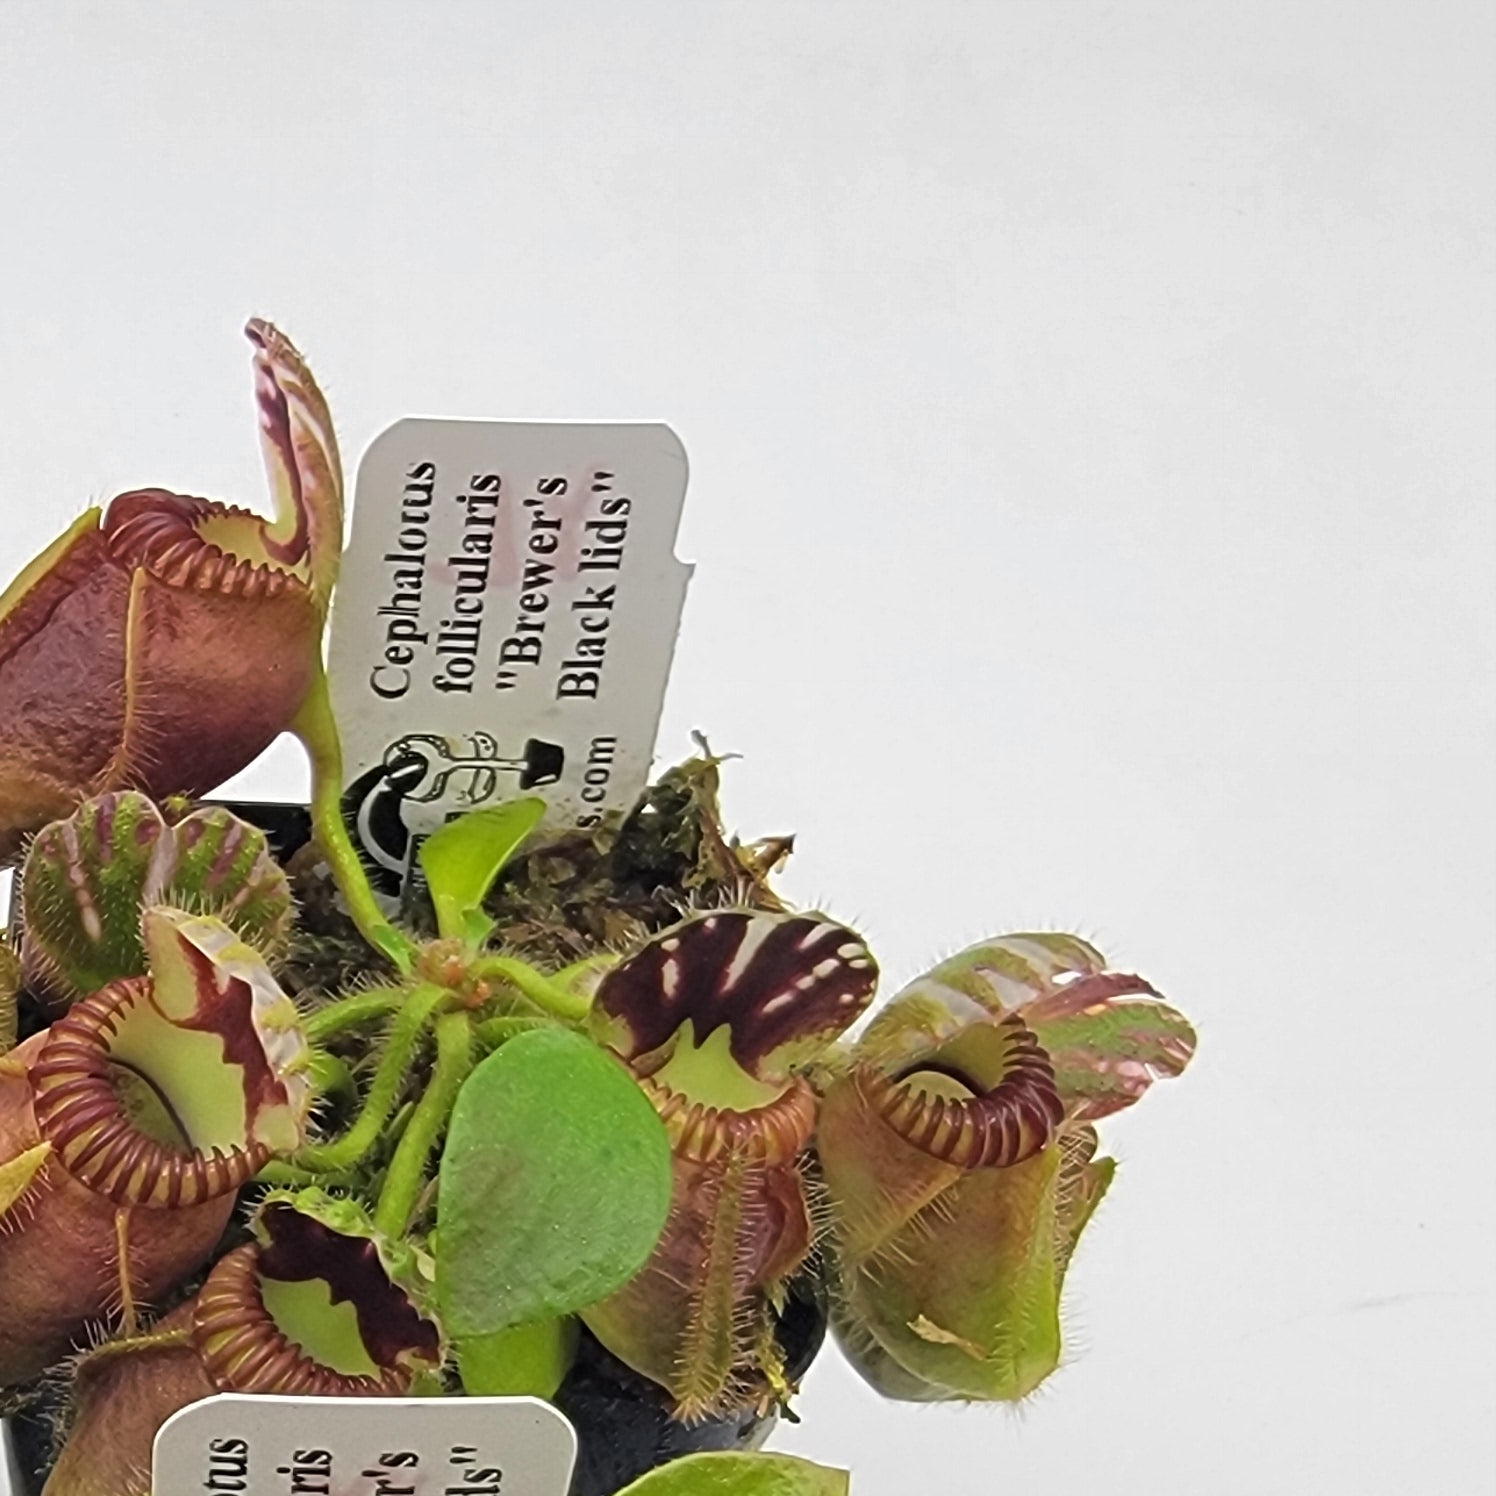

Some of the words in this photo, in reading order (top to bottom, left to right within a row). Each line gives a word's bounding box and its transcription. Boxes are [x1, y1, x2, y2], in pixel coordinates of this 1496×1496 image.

[370, 462, 436, 700] Cephalotus
[432, 474, 502, 694] follicularis
[495, 477, 568, 690] "Brewer's
[577, 471, 632, 573] lids"
[557, 585, 617, 700] Black
